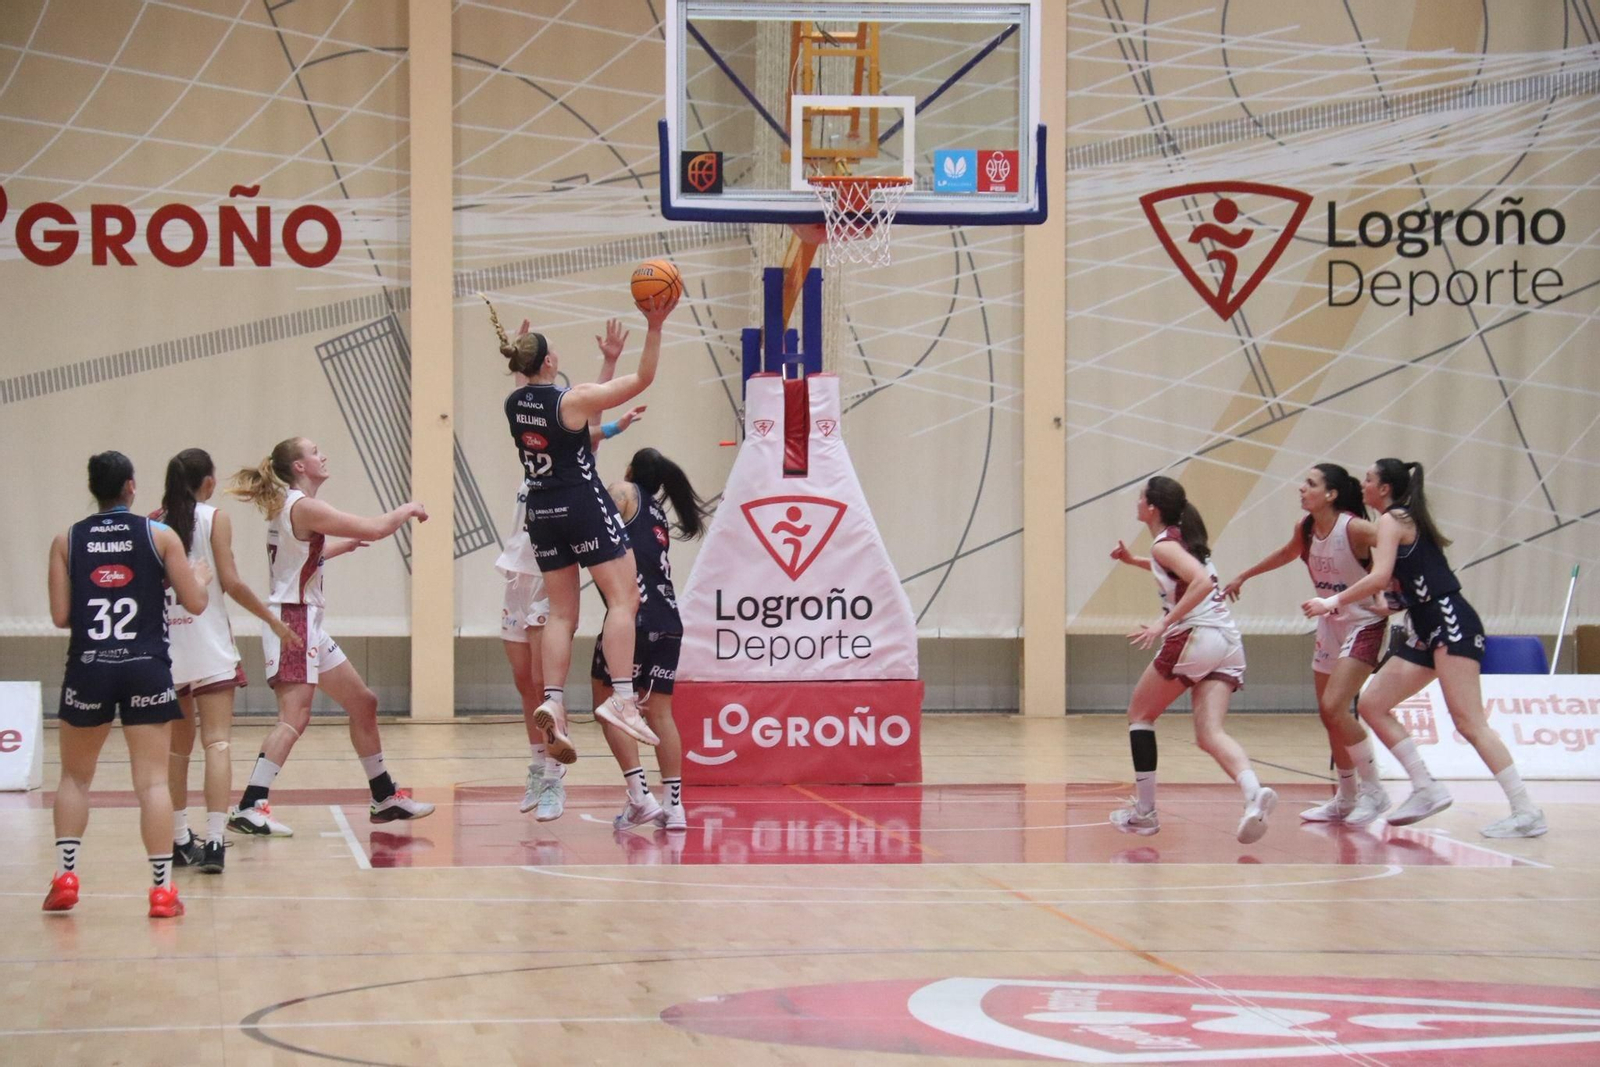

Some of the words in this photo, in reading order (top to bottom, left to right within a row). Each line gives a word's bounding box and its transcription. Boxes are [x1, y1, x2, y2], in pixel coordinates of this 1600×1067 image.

[0, 184, 342, 268] GROÑO
[1327, 196, 1566, 258] Logroño
[1327, 260, 1564, 316] Deporte
[516, 413, 548, 428] KELLIHER
[90, 524, 130, 533] ABANCA
[86, 540, 133, 553] SALINAS
[569, 537, 600, 555] calvi
[87, 597, 138, 640] 32
[716, 588, 873, 628] Logroño
[716, 629, 872, 666] Deporte
[649, 664, 676, 681] Reca
[1484, 694, 1600, 722] yunta
[703, 703, 911, 748] LOGROÑO
[1513, 723, 1600, 752] Logr
